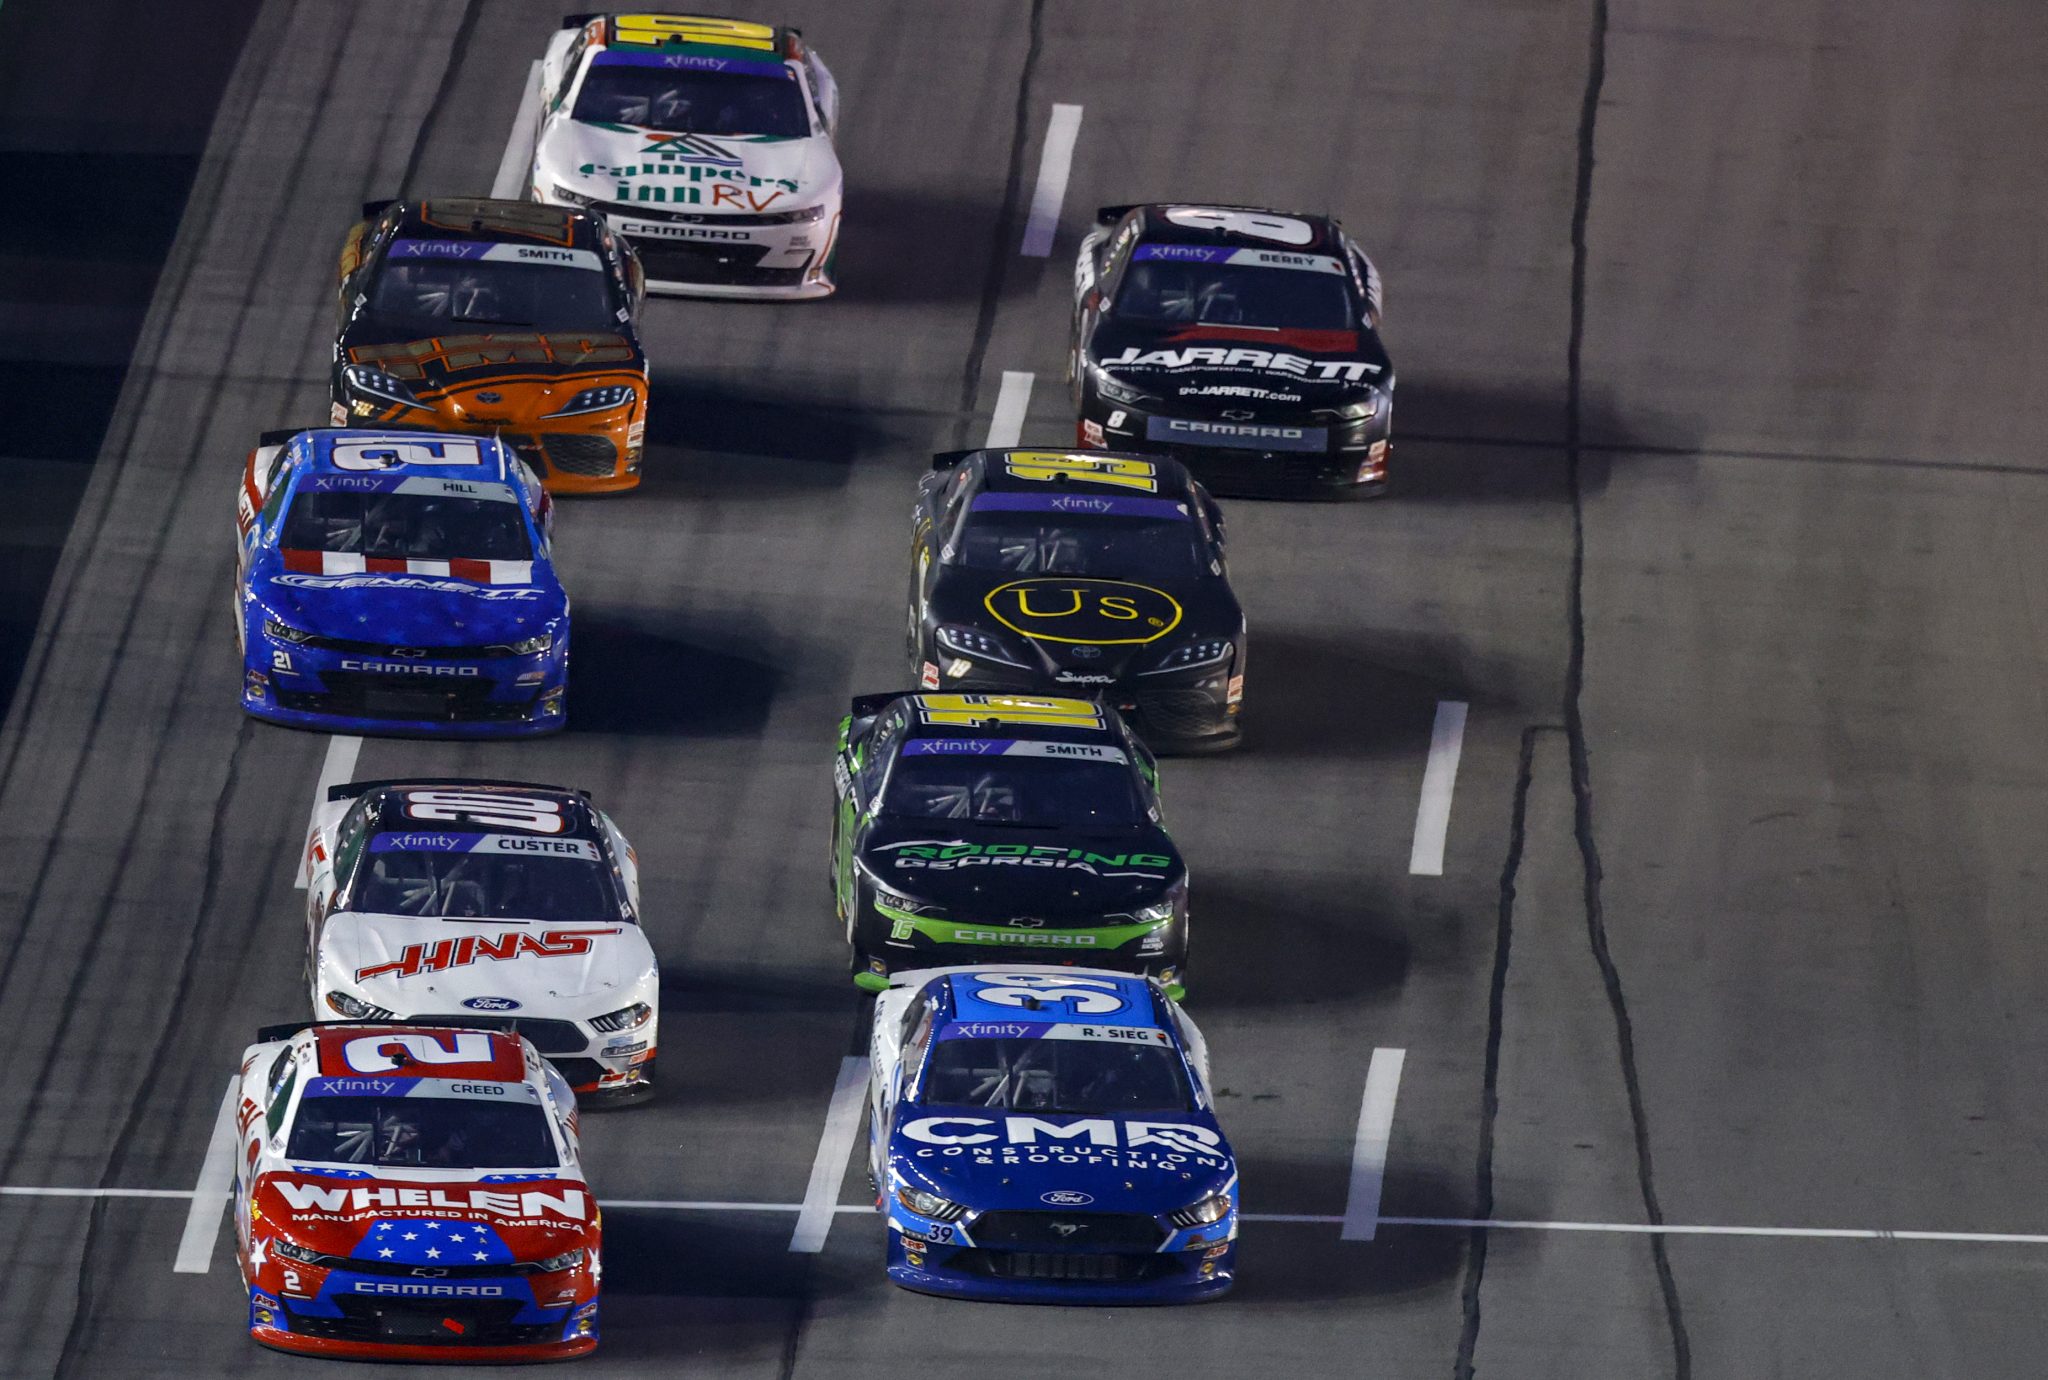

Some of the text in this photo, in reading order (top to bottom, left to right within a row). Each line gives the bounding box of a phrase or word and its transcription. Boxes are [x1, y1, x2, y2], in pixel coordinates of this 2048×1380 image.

[664, 55, 728, 71] xfinity
[616, 181, 784, 212] inn RV
[622, 223, 751, 241] CAMARO
[407, 242, 472, 260] xfinity
[518, 248, 574, 262] SMITH
[1150, 246, 1216, 262] xfinity
[1260, 252, 1315, 267] BERRY
[1100, 347, 1382, 382] JARRETT
[1107, 410, 1127, 428] 8
[1169, 420, 1303, 438] CAMARO
[315, 475, 384, 492] xfinity
[443, 482, 477, 494] HILL
[1051, 496, 1113, 513] xfinity
[273, 650, 291, 669] 21
[341, 660, 478, 677] CAMARO
[921, 740, 992, 755] xfinity
[1045, 744, 1103, 757] SMITH
[390, 834, 460, 851] xfinity
[498, 838, 580, 855] CUSTER
[894, 856, 1099, 876] GEORGIA
[890, 919, 916, 940] 16
[954, 929, 1096, 945] CAMARO
[472, 997, 511, 1011] Ford
[957, 1022, 1030, 1039] xfinity
[1083, 1027, 1149, 1041] R. SIEG
[322, 1078, 396, 1095] xfinity
[451, 1083, 505, 1096] CREED
[902, 1116, 1224, 1158] CMR
[916, 1145, 1216, 1168] CONSTRUCTION
[271, 1181, 587, 1221] WHELEN
[1049, 1192, 1084, 1206] Ford
[292, 1209, 586, 1236] MANUFACTURED IN AMERICA
[928, 1224, 954, 1243] 39
[283, 1269, 302, 1291] 2
[355, 1281, 503, 1296] CAMARO
